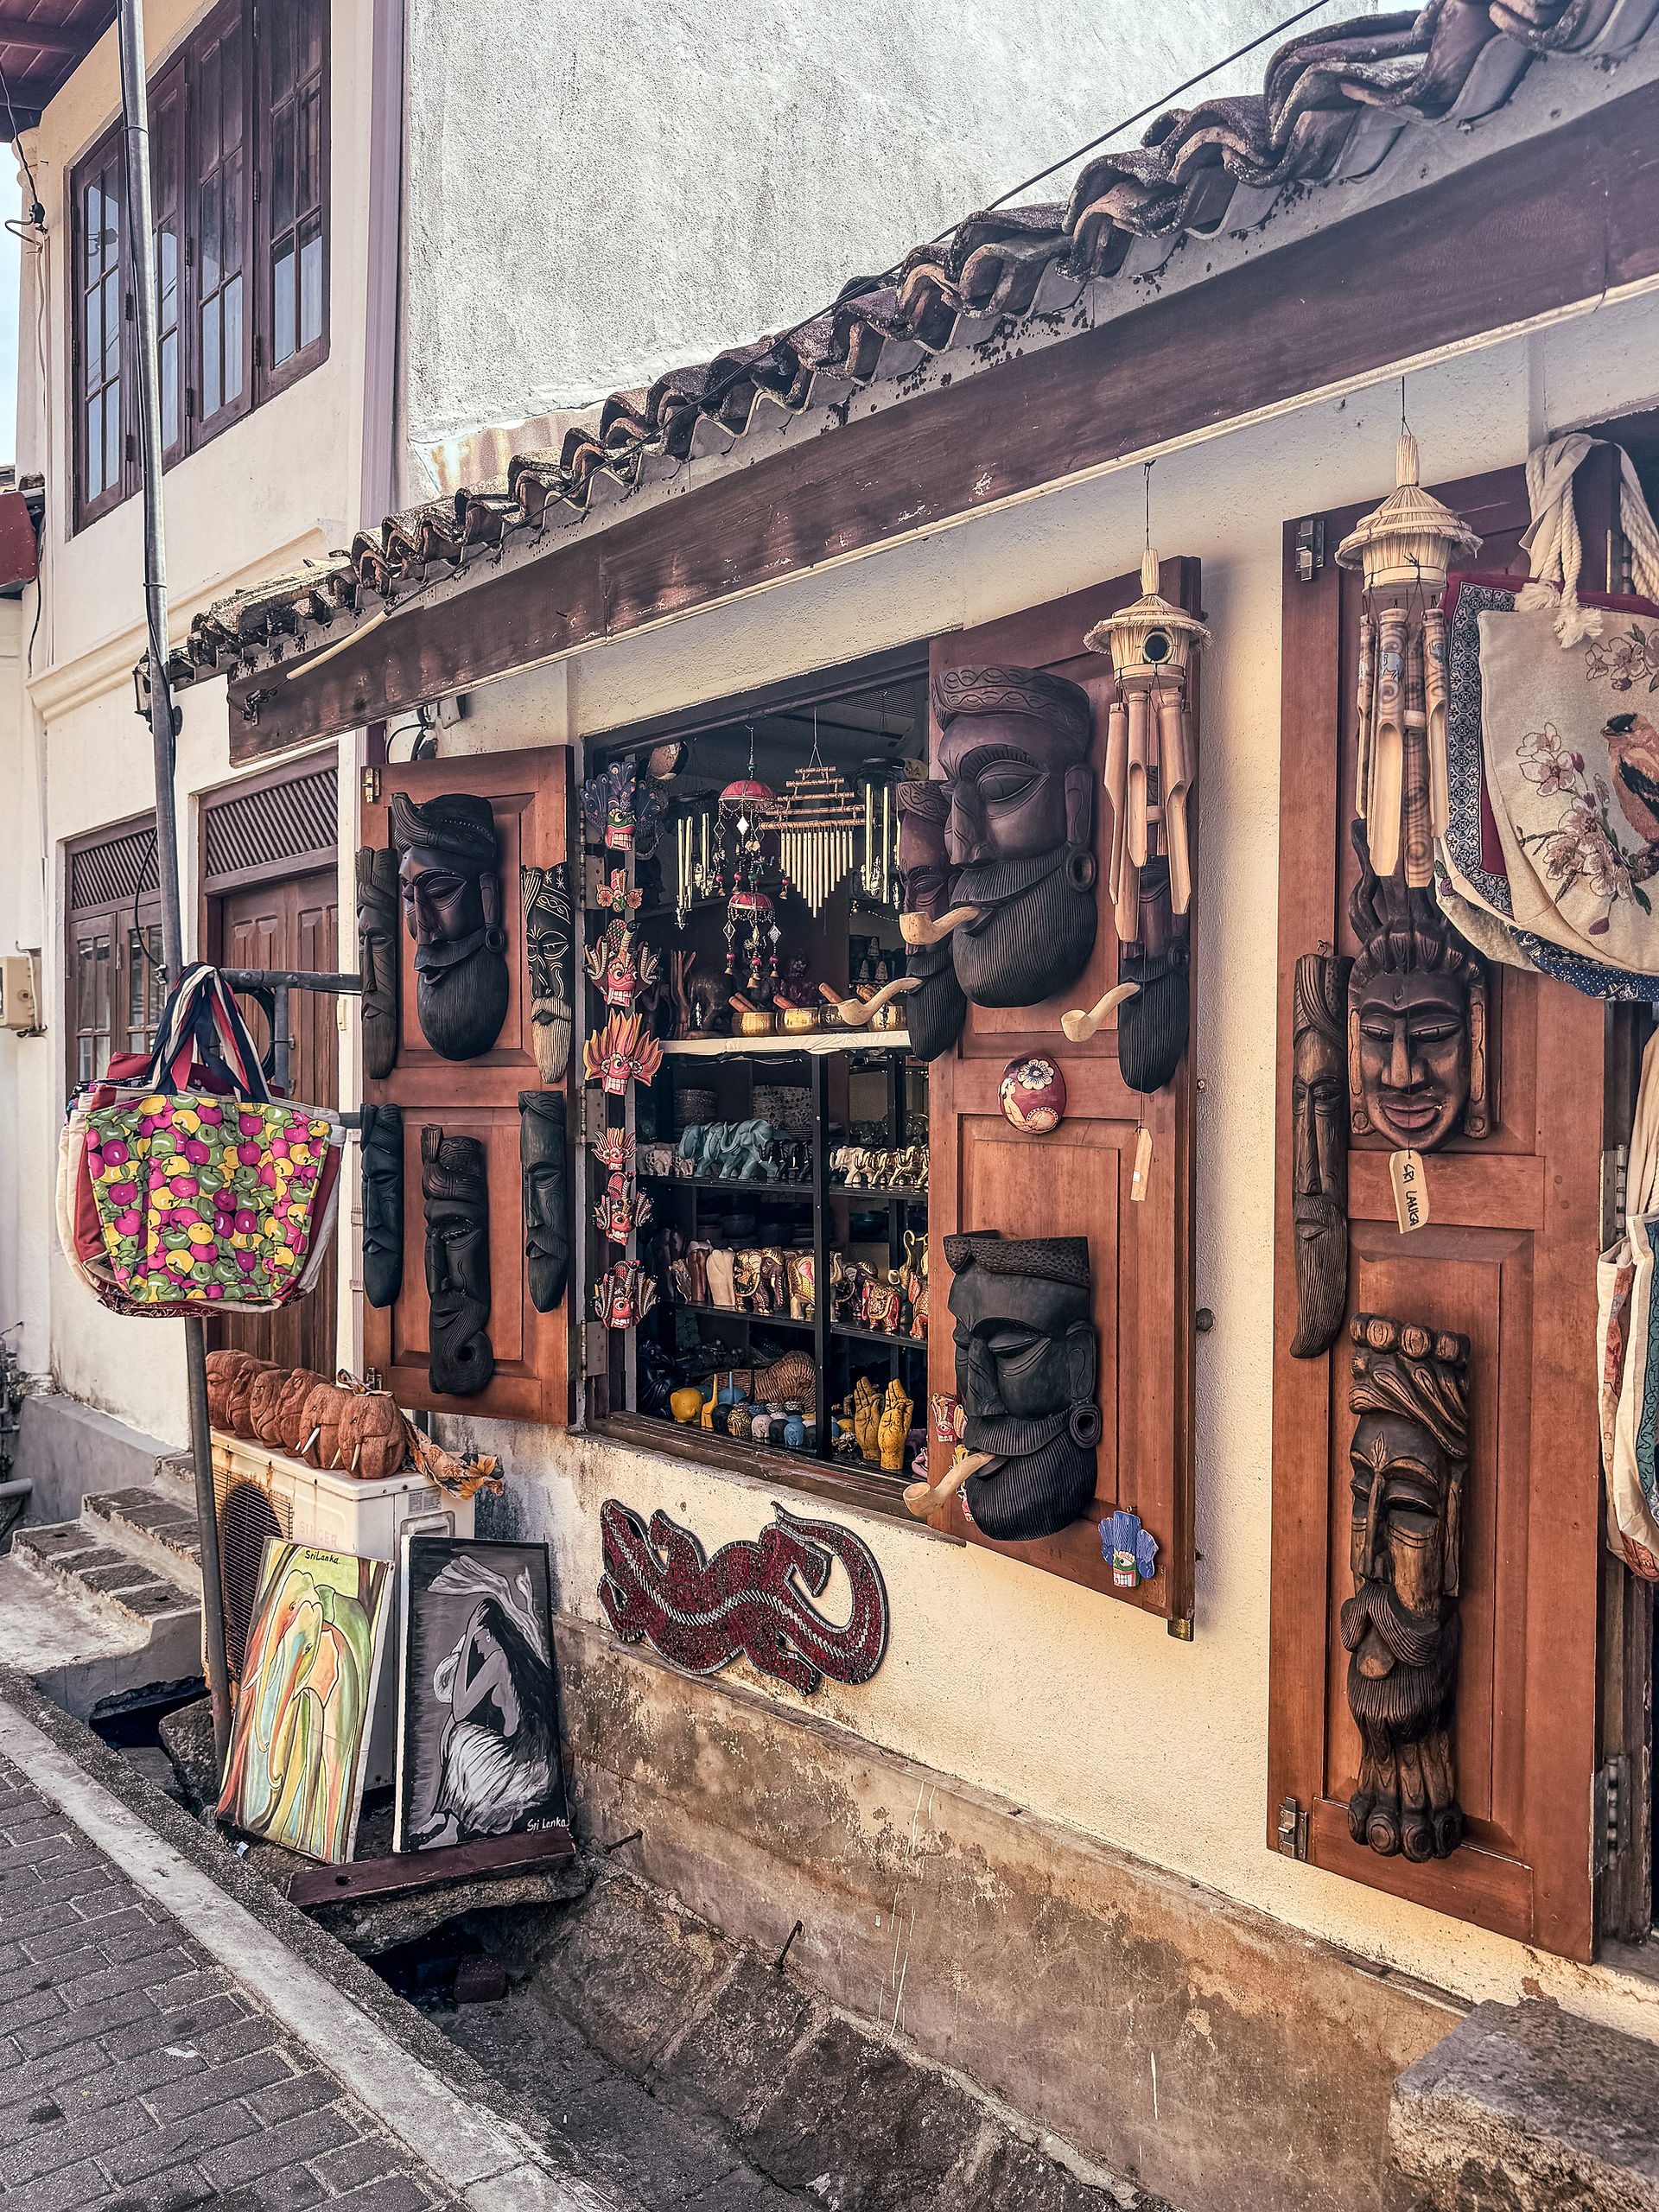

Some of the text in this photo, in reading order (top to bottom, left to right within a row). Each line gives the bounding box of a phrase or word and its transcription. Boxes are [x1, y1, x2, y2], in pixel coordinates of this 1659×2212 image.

[1402, 1163, 1420, 1226] SRI LANKA
[527, 1816, 567, 1832] Sri Lanka
